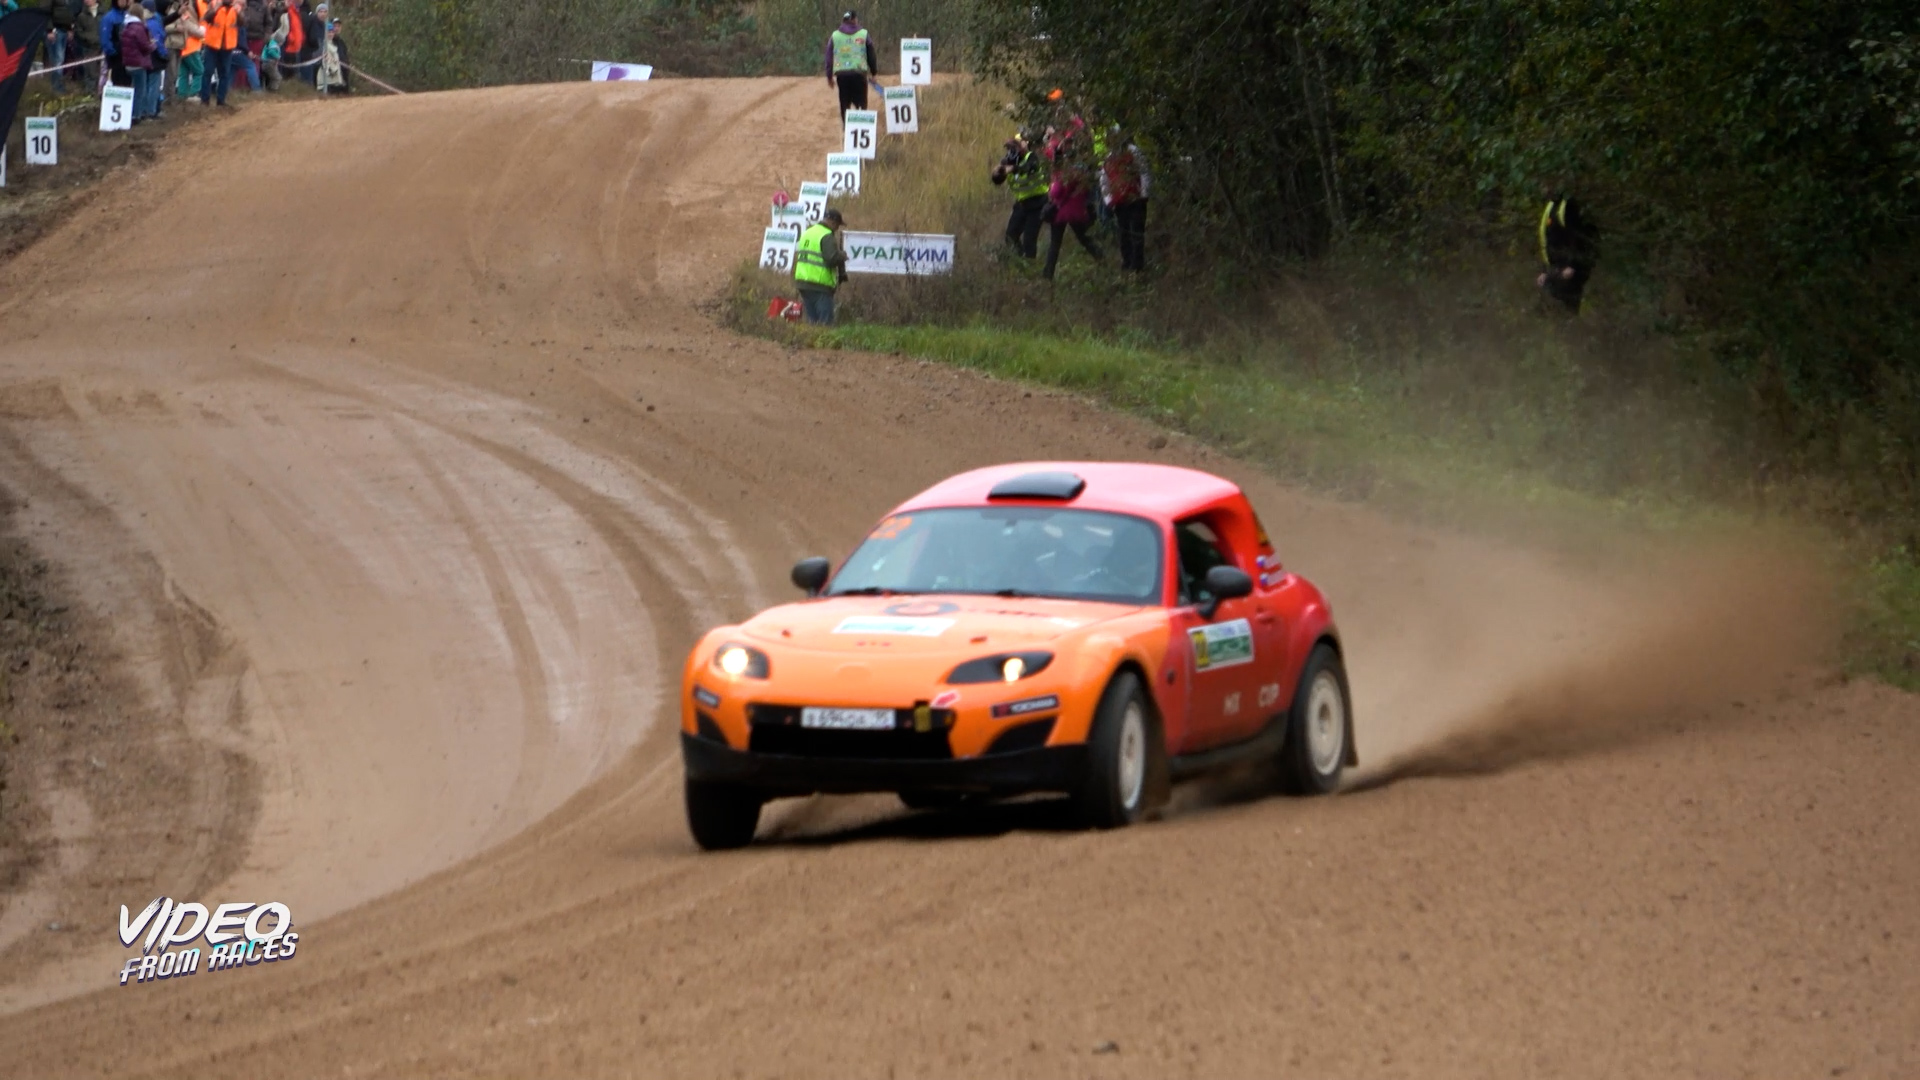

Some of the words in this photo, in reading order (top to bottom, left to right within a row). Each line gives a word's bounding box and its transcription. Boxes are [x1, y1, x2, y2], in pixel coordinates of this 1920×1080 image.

[911, 56, 921, 75] 5
[110, 104, 122, 123] 5
[891, 104, 911, 124] 10
[31, 135, 51, 155] 10
[850, 128, 870, 149] 15
[831, 171, 855, 191] 20
[763, 247, 789, 270] 35
[850, 245, 948, 262] УРАЛХИМ
